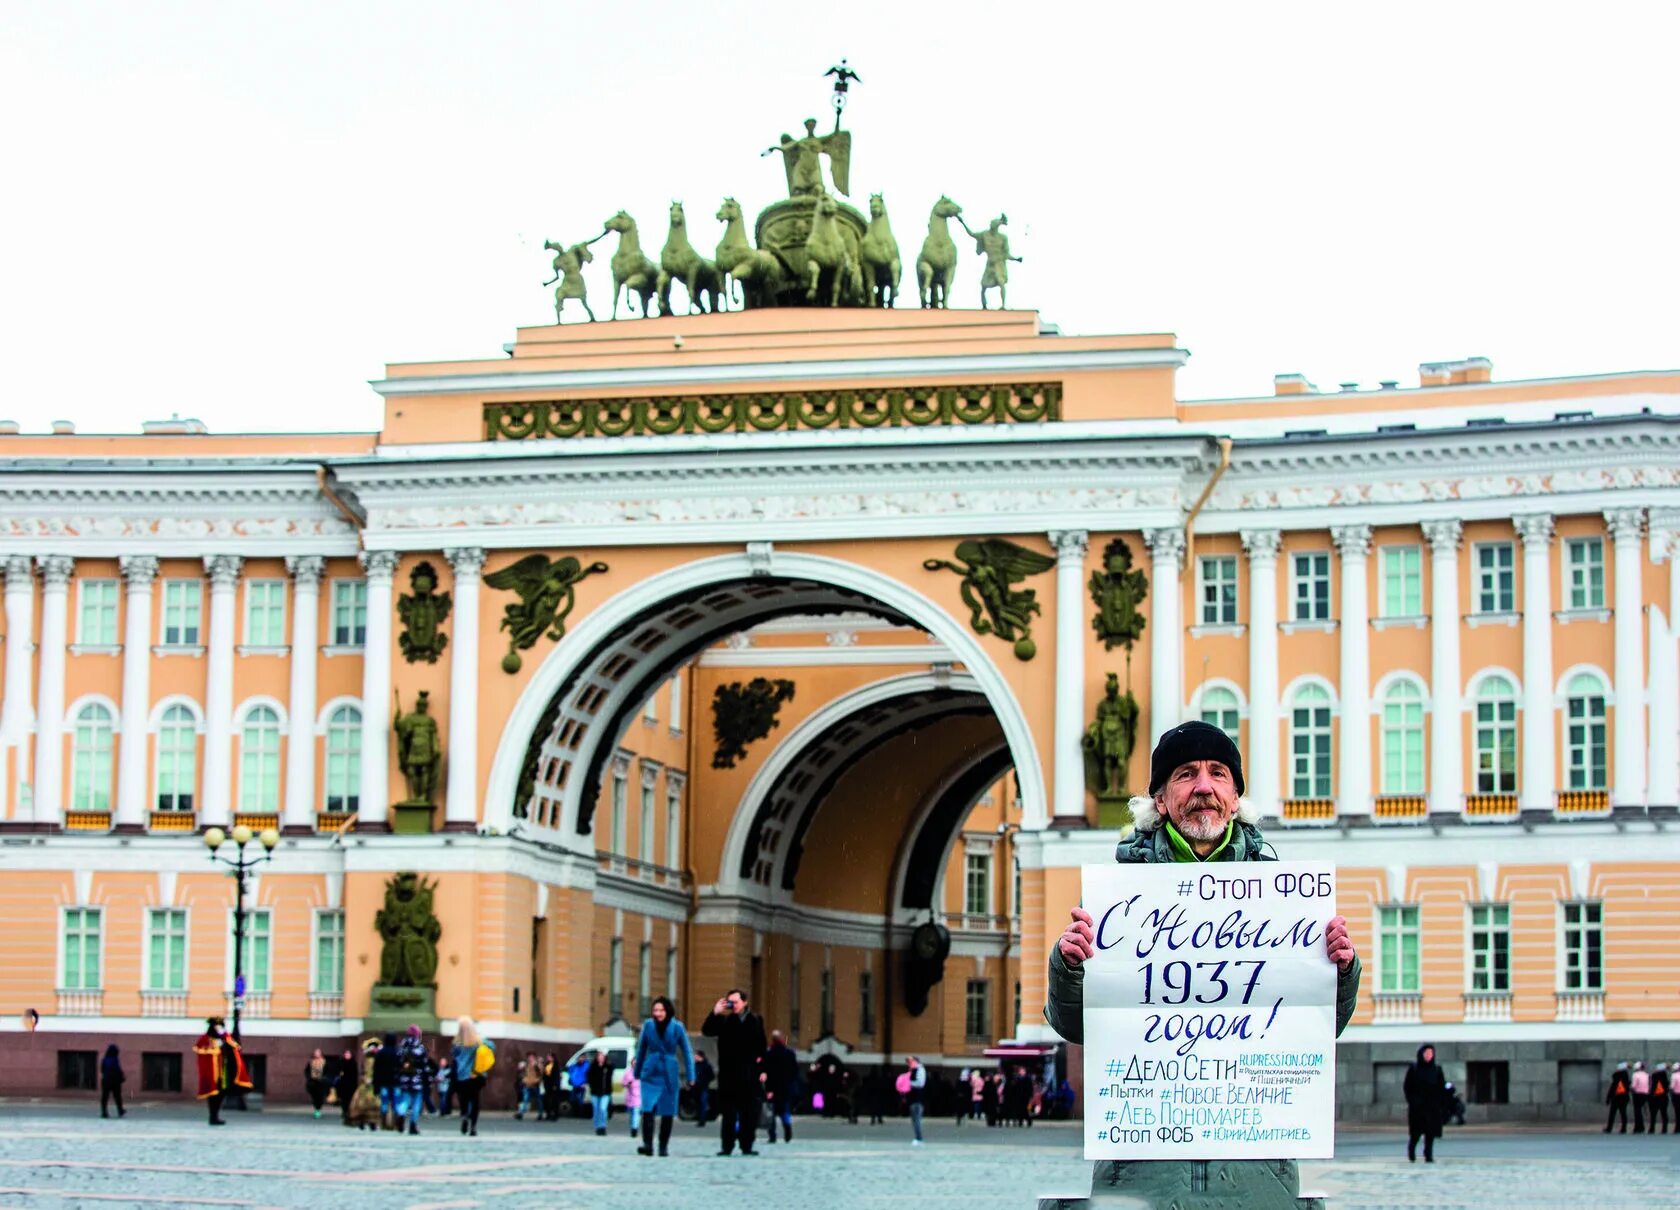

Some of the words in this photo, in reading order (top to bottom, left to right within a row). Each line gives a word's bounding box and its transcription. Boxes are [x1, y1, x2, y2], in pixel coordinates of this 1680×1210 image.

[1275, 873, 1331, 898] ФСБ
[1096, 894, 1142, 950] С
[1135, 902, 1321, 960] Новым
[1137, 959, 1266, 1006] 1937
[1157, 1125, 1193, 1143] ФСБ
